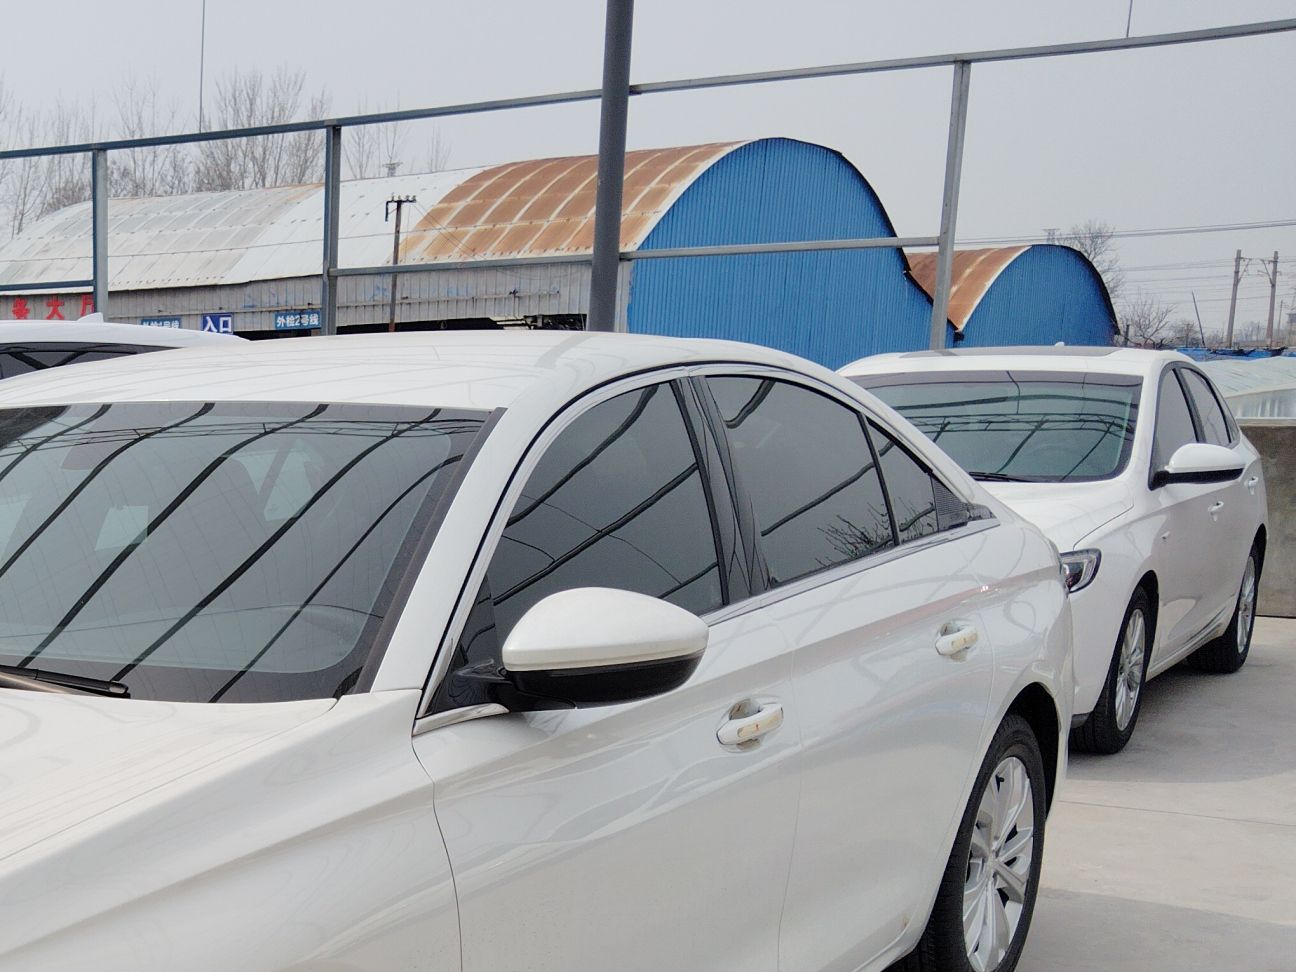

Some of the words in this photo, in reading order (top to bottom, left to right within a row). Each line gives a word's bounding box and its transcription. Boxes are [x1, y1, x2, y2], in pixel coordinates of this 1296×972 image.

[204, 316, 233, 333] 入口
[276, 313, 319, 327] 外检2号线
